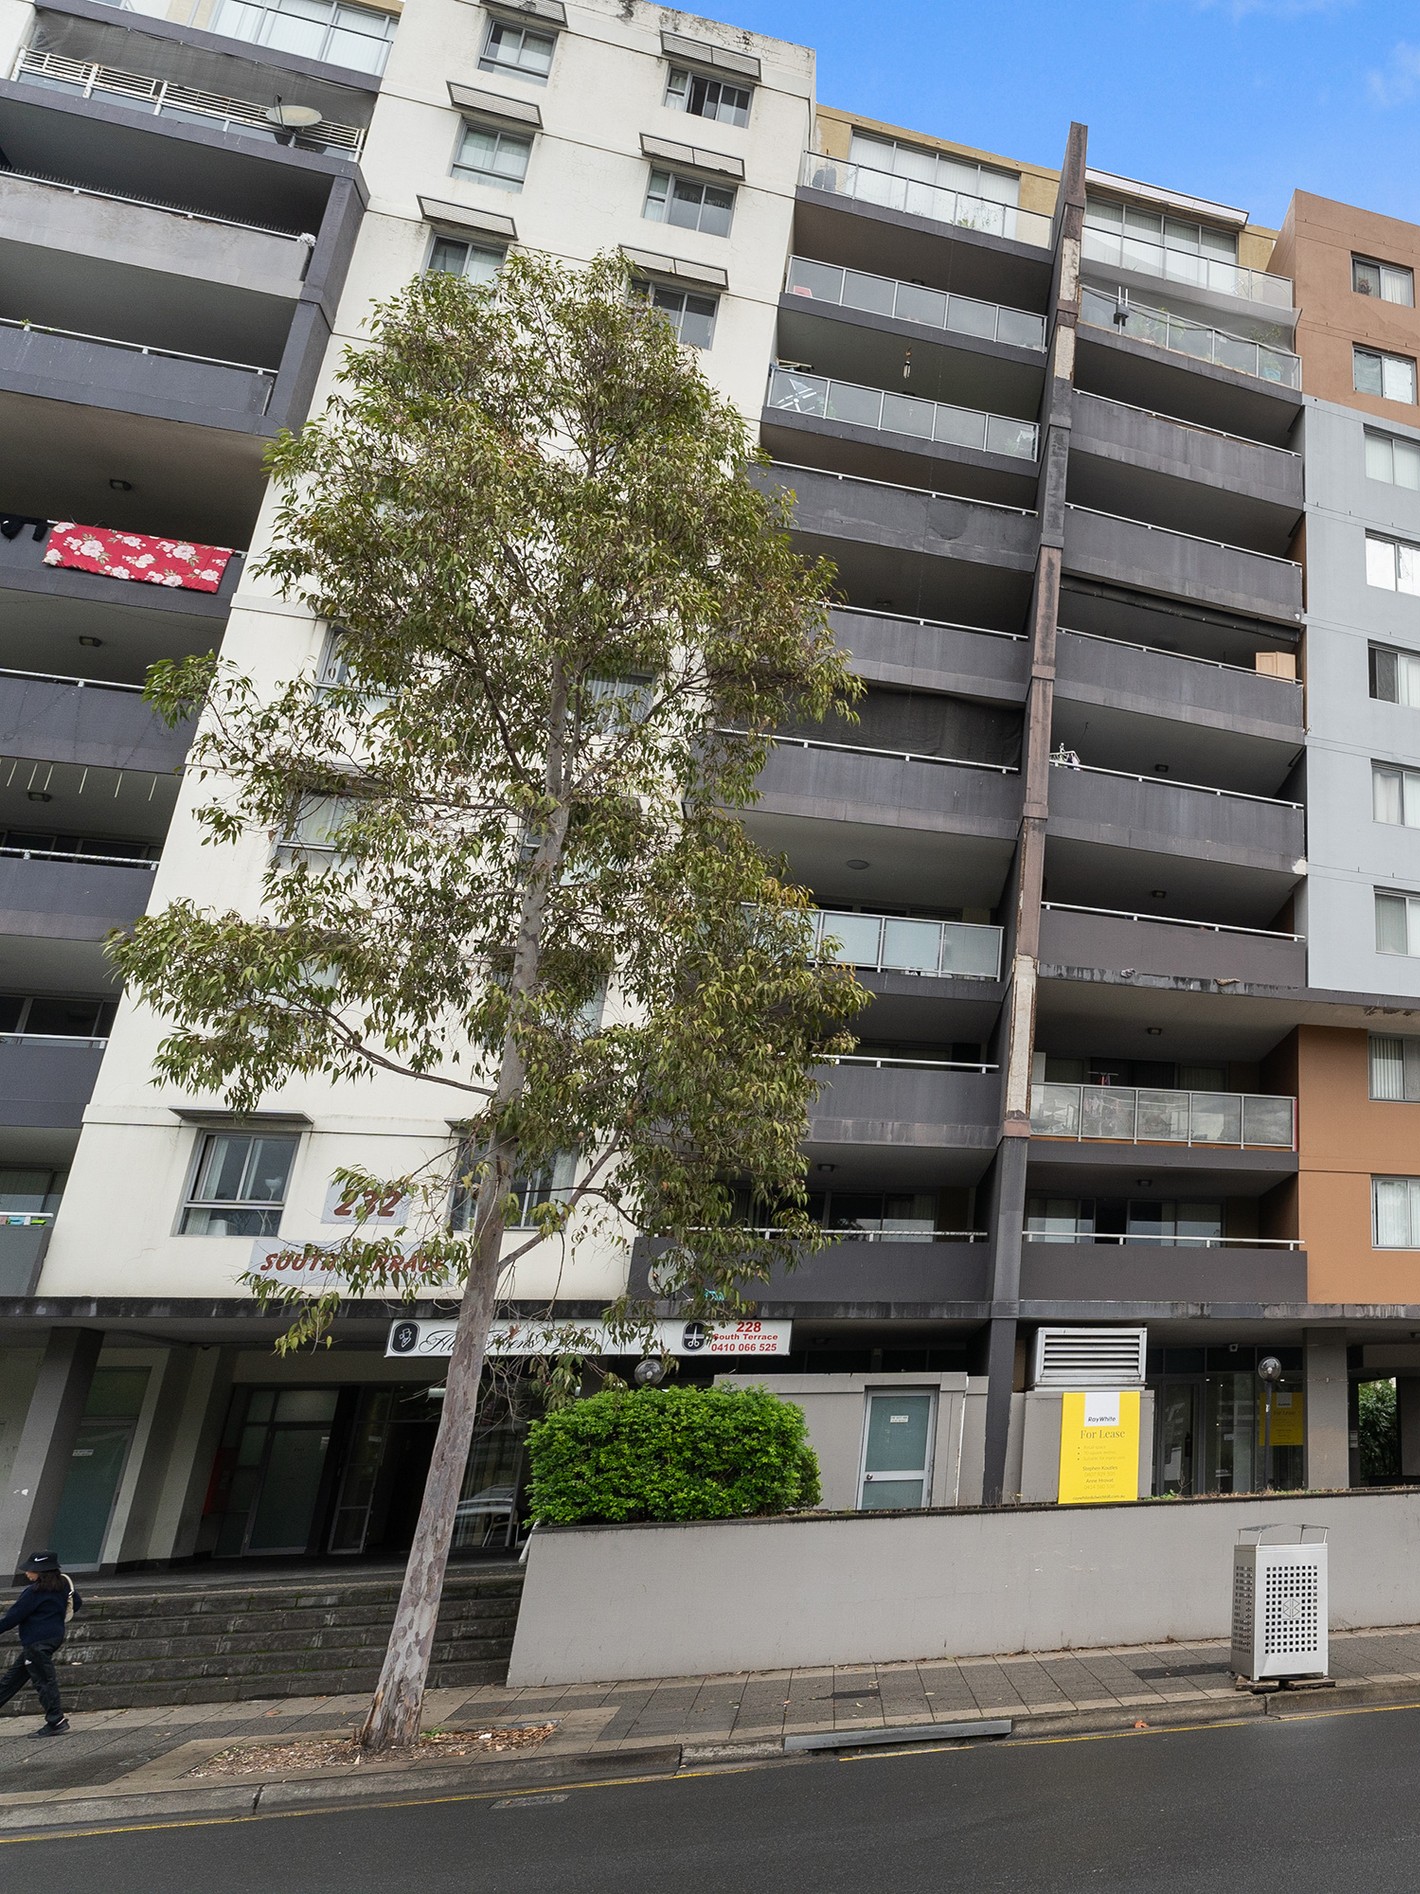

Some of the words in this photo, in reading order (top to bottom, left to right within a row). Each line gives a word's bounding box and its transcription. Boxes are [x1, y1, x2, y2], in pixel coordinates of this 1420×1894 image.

[736, 1321, 762, 1333] 228
[712, 1333, 740, 1341] South
[743, 1333, 779, 1341] Terrace
[711, 1343, 736, 1352] 0410
[738, 1343, 757, 1352] 066
[759, 1343, 778, 1352] 525
[1080, 1429, 1097, 1440] For
[1099, 1429, 1126, 1439] Lease
